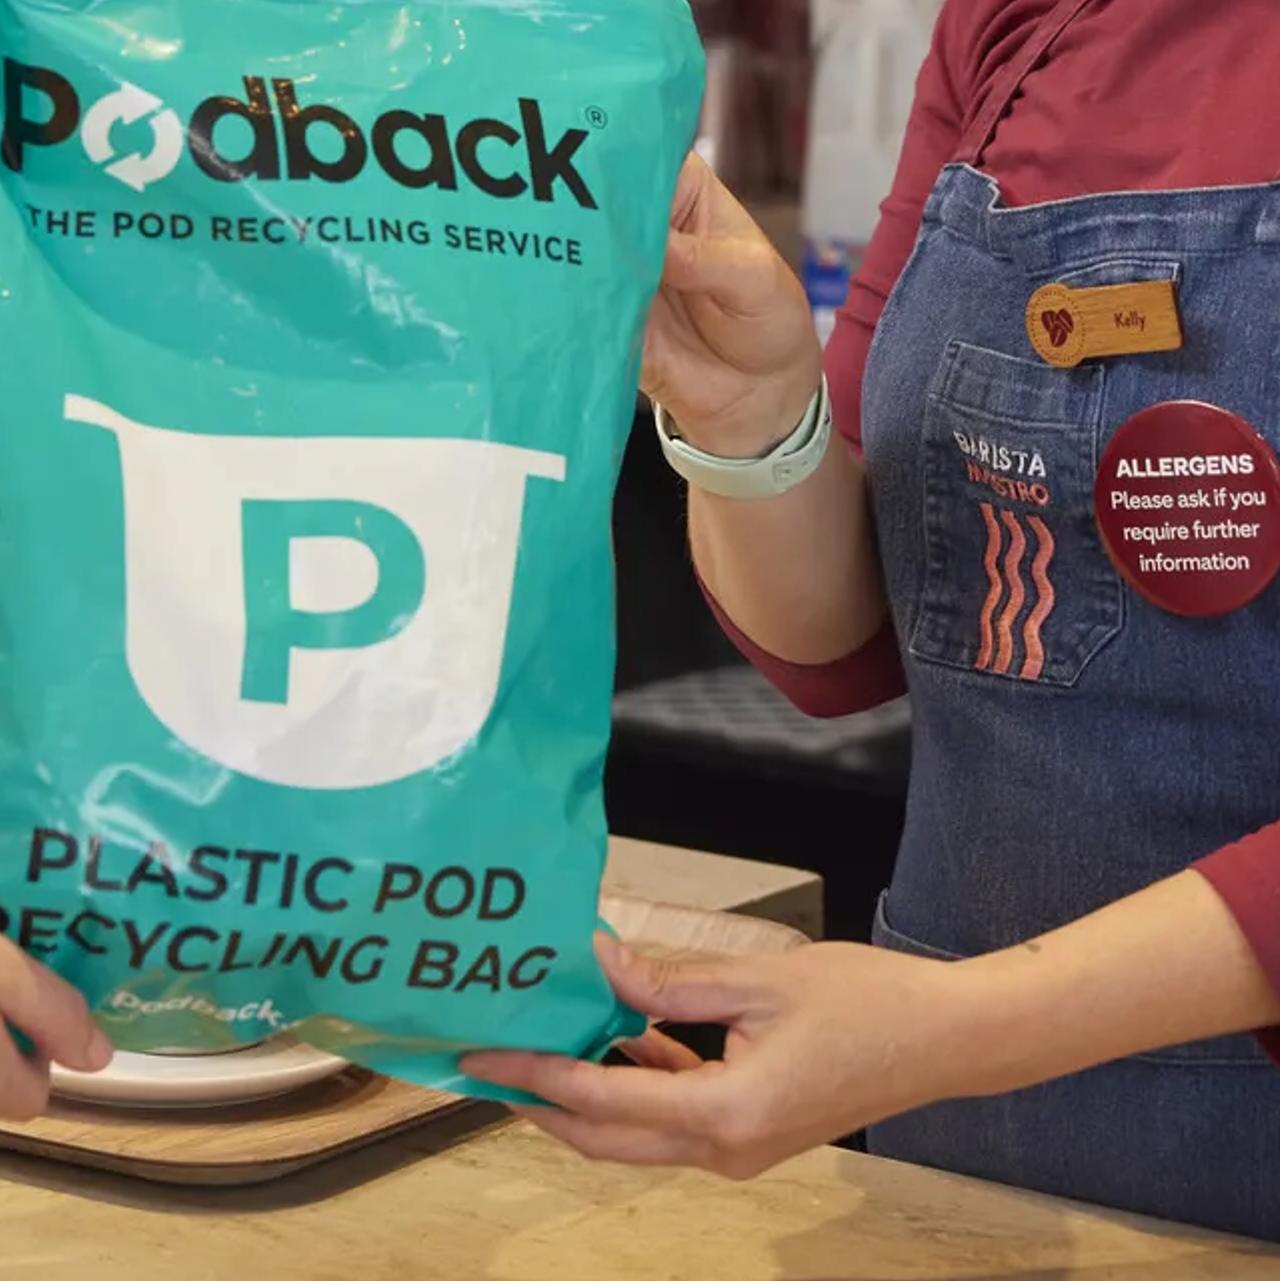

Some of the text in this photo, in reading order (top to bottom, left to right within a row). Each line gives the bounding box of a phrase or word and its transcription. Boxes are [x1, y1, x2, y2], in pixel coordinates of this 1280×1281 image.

[26, 204, 584, 266] THE POD RECYCLING SERVICE
[1113, 310, 1146, 332] Kelly
[1116, 454, 1254, 478] ALLERGENS
[1111, 487, 1267, 511] Please ask if you
[1123, 519, 1260, 545] require further
[1139, 553, 1250, 572] information
[25, 826, 526, 922] PLASTIC POD
[408, 940, 558, 993] BAG
